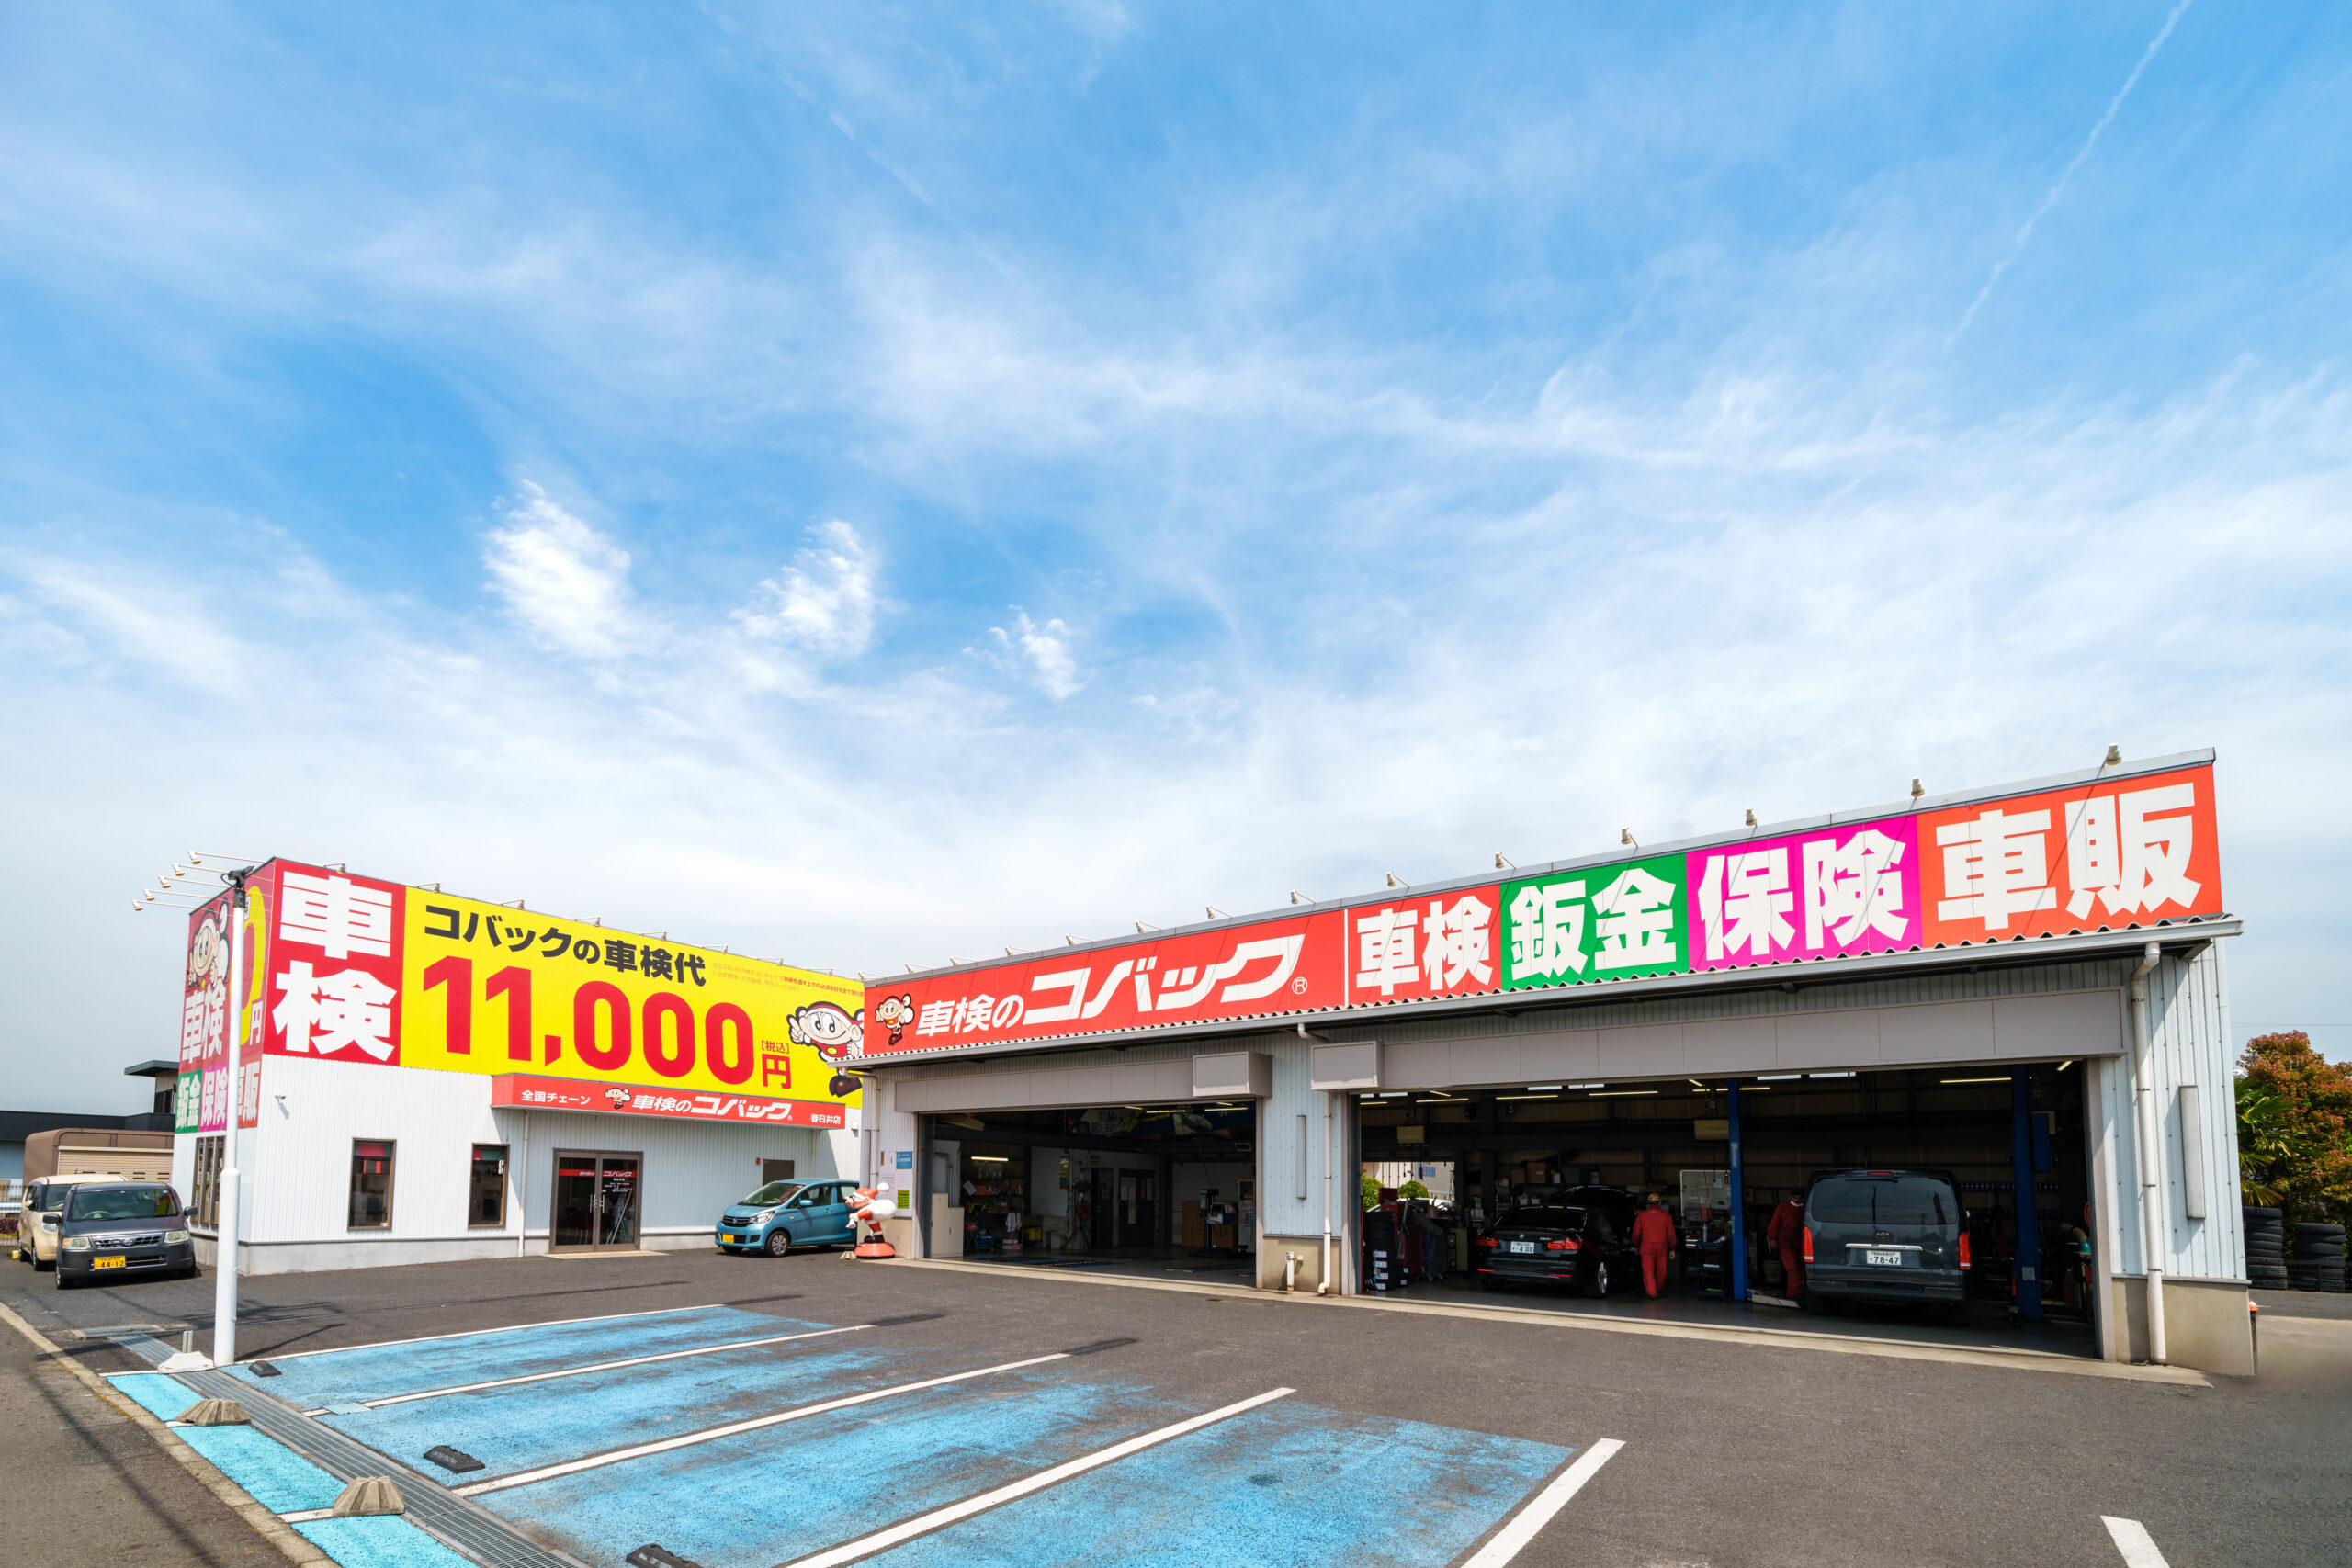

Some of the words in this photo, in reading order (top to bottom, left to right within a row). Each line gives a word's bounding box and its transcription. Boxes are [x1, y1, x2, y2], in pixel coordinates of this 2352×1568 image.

[1355, 895, 1493, 996] 車検
[1509, 867, 1678, 980] 鈑金
[1697, 829, 1909, 961] 保険
[1935, 782, 2202, 931] 車販
[274, 871, 397, 1062] 車検
[424, 905, 707, 987] コバックの車検代
[915, 933, 1306, 1037] 車検のコバック
[182, 978, 227, 1064] 車検
[249, 1000, 264, 1046] 円
[423, 954, 755, 1086] 11,000
[175, 1073, 201, 1130] 鈑金
[201, 1066, 229, 1127] 保険
[521, 1089, 591, 1106] 全国チェーン
[761, 1053, 792, 1090] 円
[631, 1094, 793, 1120] 車検のコバック
[810, 1113, 842, 1125] 春日井店
[1874, 1256, 1900, 1265] 78-47
